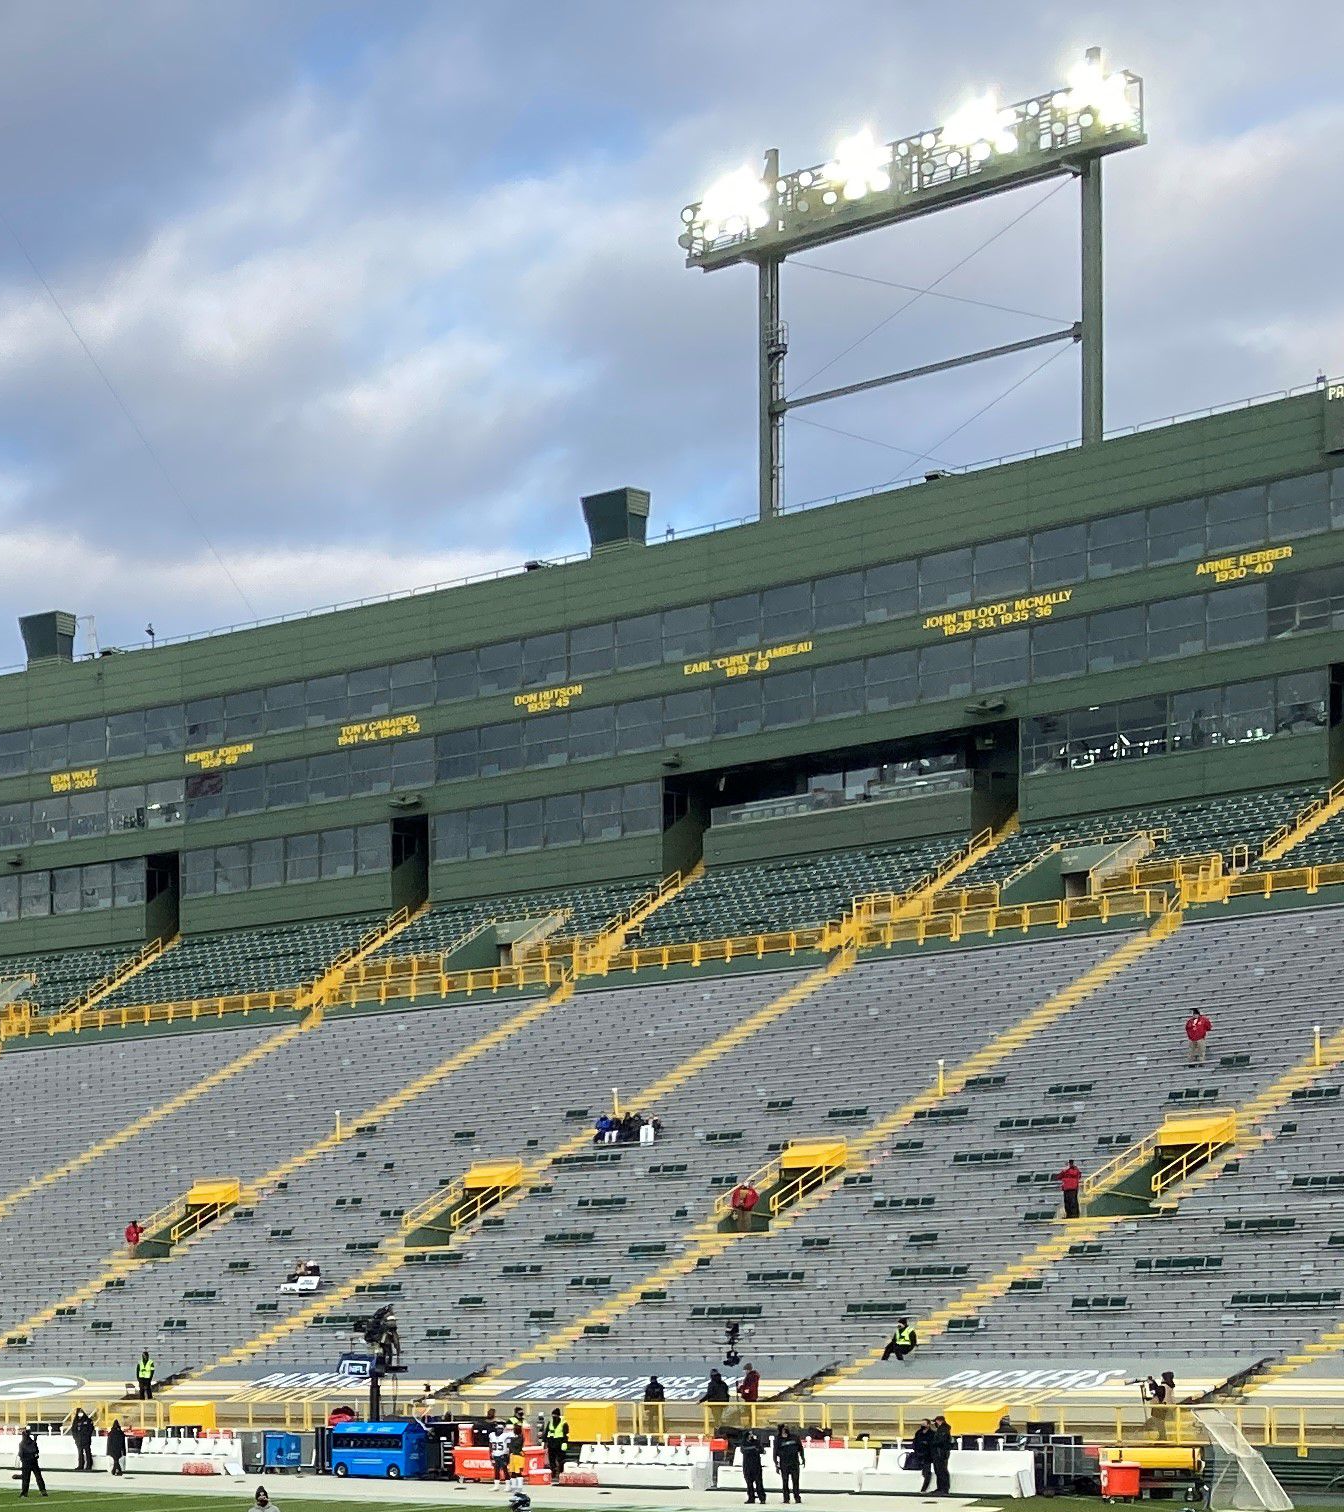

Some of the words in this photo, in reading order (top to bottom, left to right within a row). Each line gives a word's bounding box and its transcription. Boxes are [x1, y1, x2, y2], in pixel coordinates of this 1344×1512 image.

[1196, 556, 1237, 576] ARNIE
[1239, 546, 1293, 567] HERBER
[922, 613, 956, 629] JOHN
[1012, 589, 1072, 610] MCNALLY
[684, 661, 711, 675] EARL
[758, 640, 813, 661] LAMBEAU
[514, 693, 538, 707] DON
[539, 684, 583, 702] HUTSON
[341, 723, 367, 736] TONY
[368, 714, 416, 730] CANADEO
[185, 749, 215, 764] HENRY
[216, 743, 254, 759] JORDAN
[50, 773, 71, 785] RON
[71, 768, 98, 781] WOLF
[930, 1369, 1126, 1388] PACKERS
